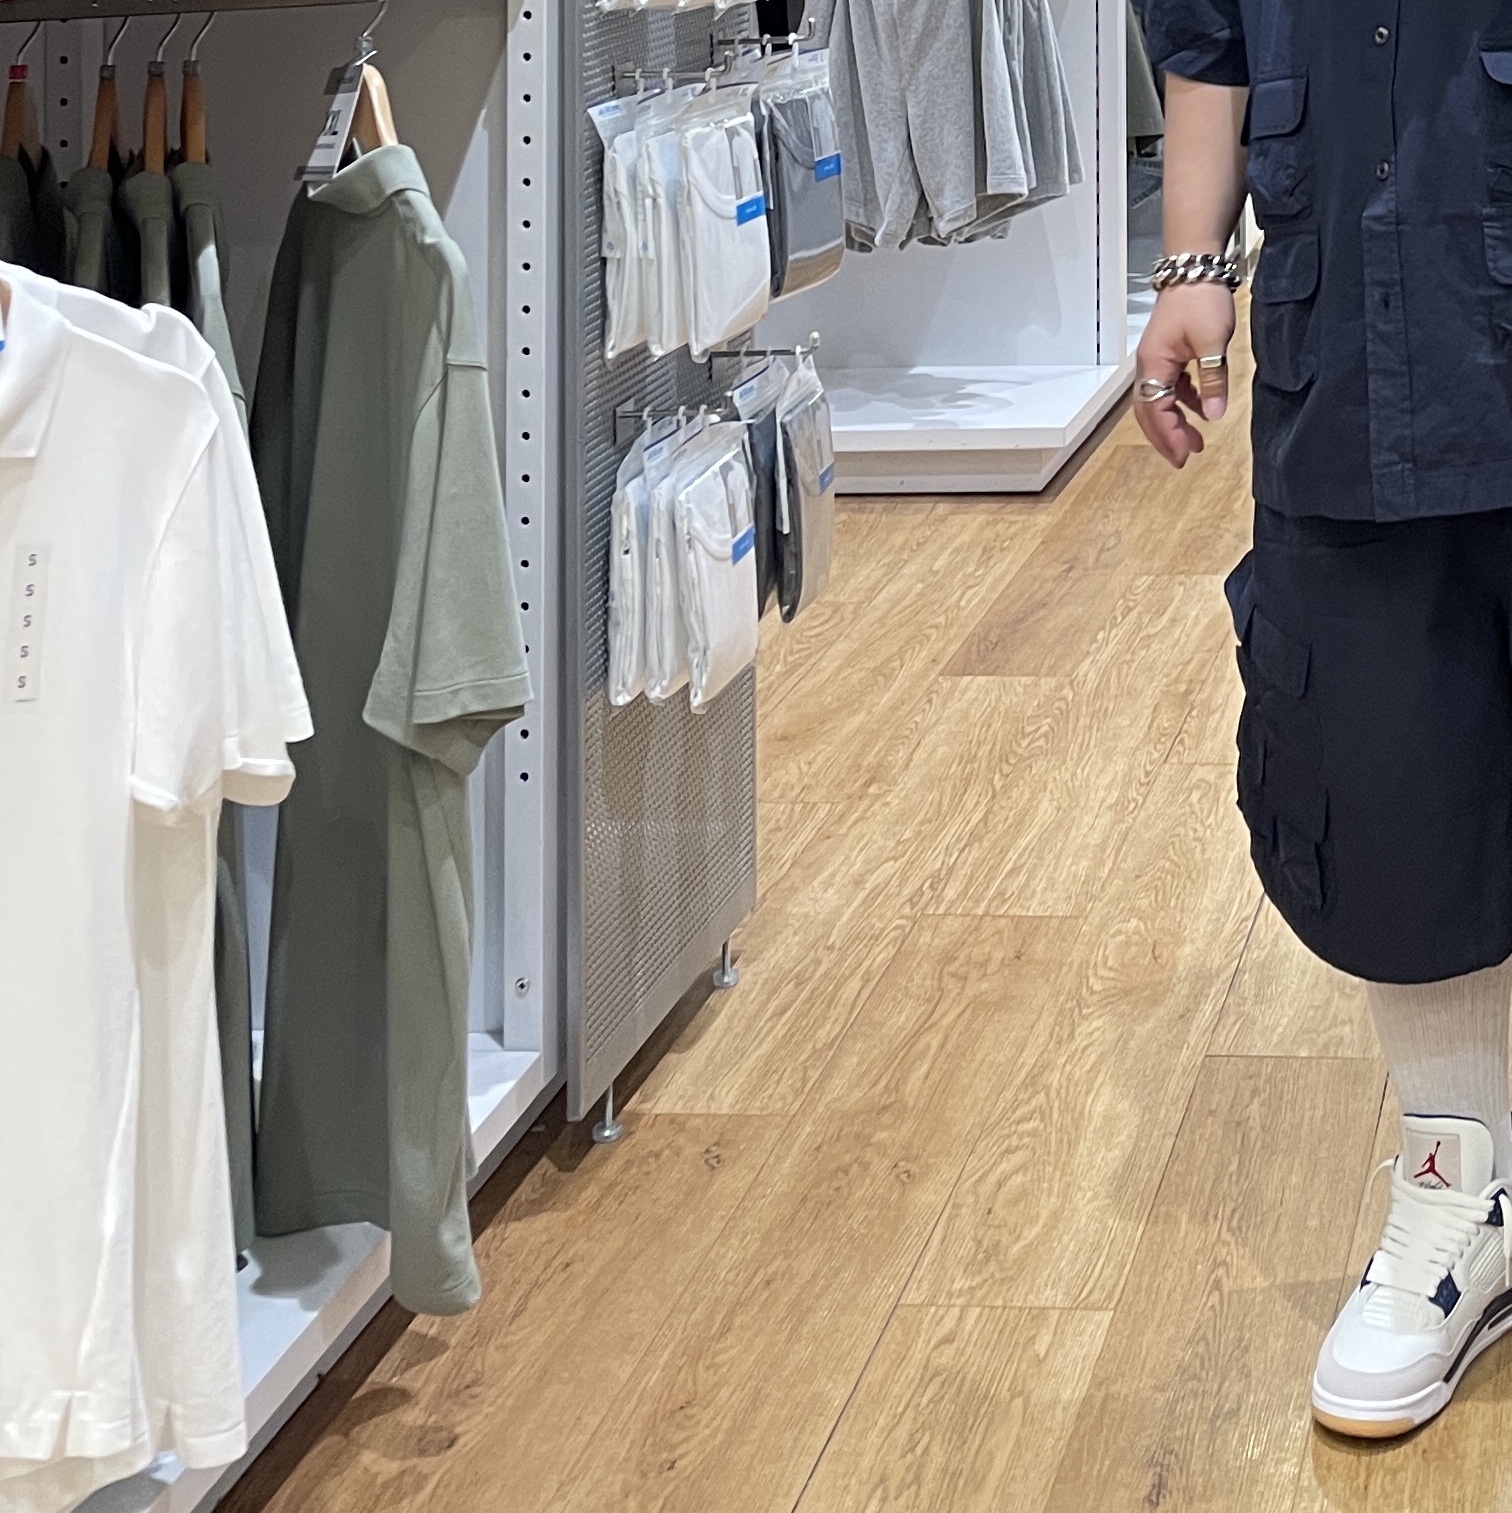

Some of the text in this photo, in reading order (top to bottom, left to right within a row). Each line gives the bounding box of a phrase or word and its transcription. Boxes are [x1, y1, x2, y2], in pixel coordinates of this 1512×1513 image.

[28, 553, 37, 567] S
[25, 583, 35, 597] S
[23, 614, 32, 628] S
[20, 645, 29, 658] S
[17, 675, 26, 689] S
